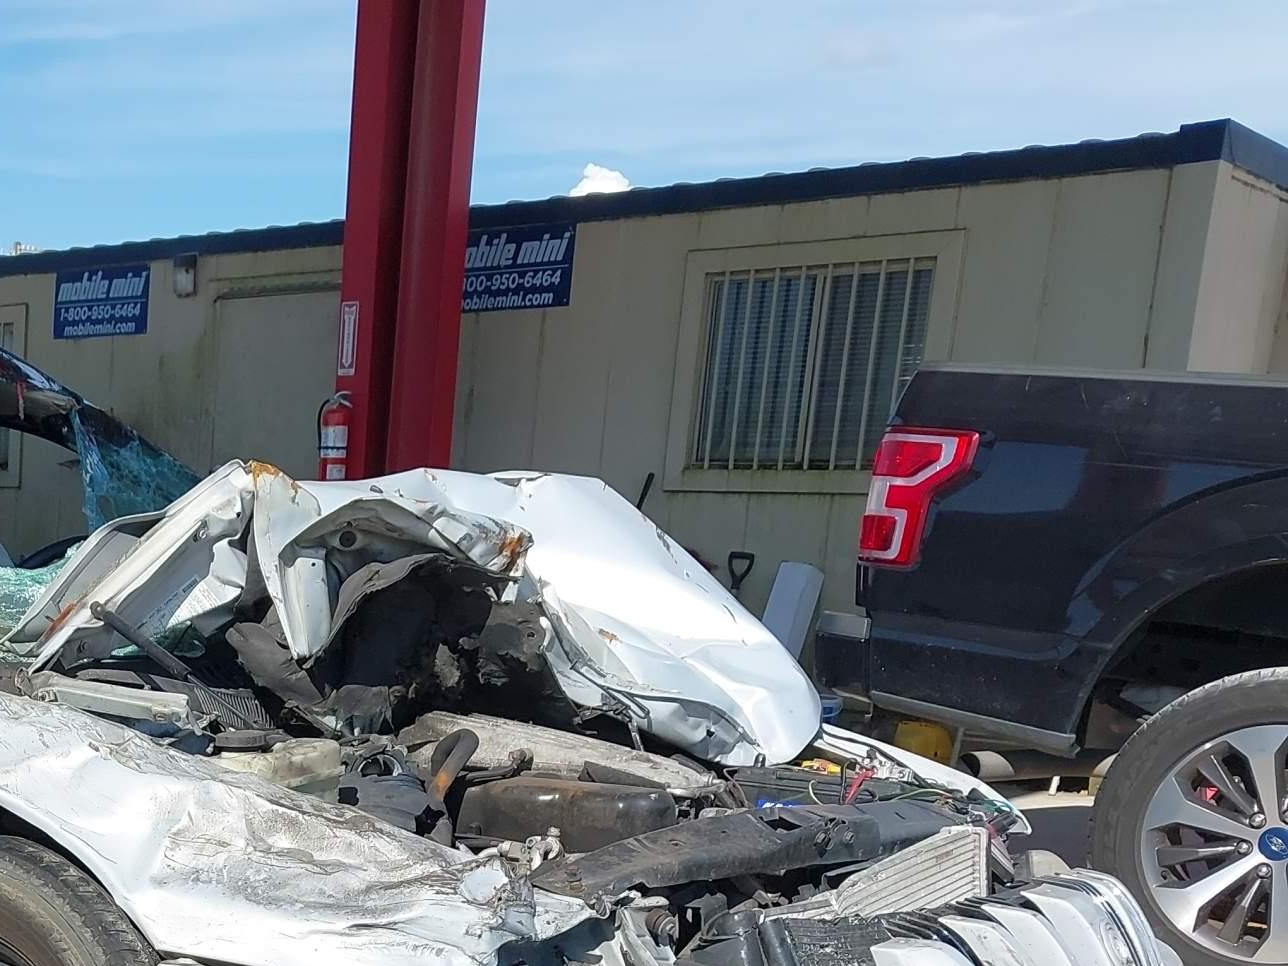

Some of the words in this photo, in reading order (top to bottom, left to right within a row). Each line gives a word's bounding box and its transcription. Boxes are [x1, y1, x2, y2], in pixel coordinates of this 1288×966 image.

[464, 233, 517, 268] obile
[516, 231, 571, 264] mini
[57, 270, 109, 302] mobile
[109, 271, 148, 298] mini
[463, 269, 562, 293] 00-950-6464
[59, 303, 141, 321] 1-800-950-6464
[461, 291, 554, 311] obilemini.com
[63, 320, 136, 337] mobilemini.com
